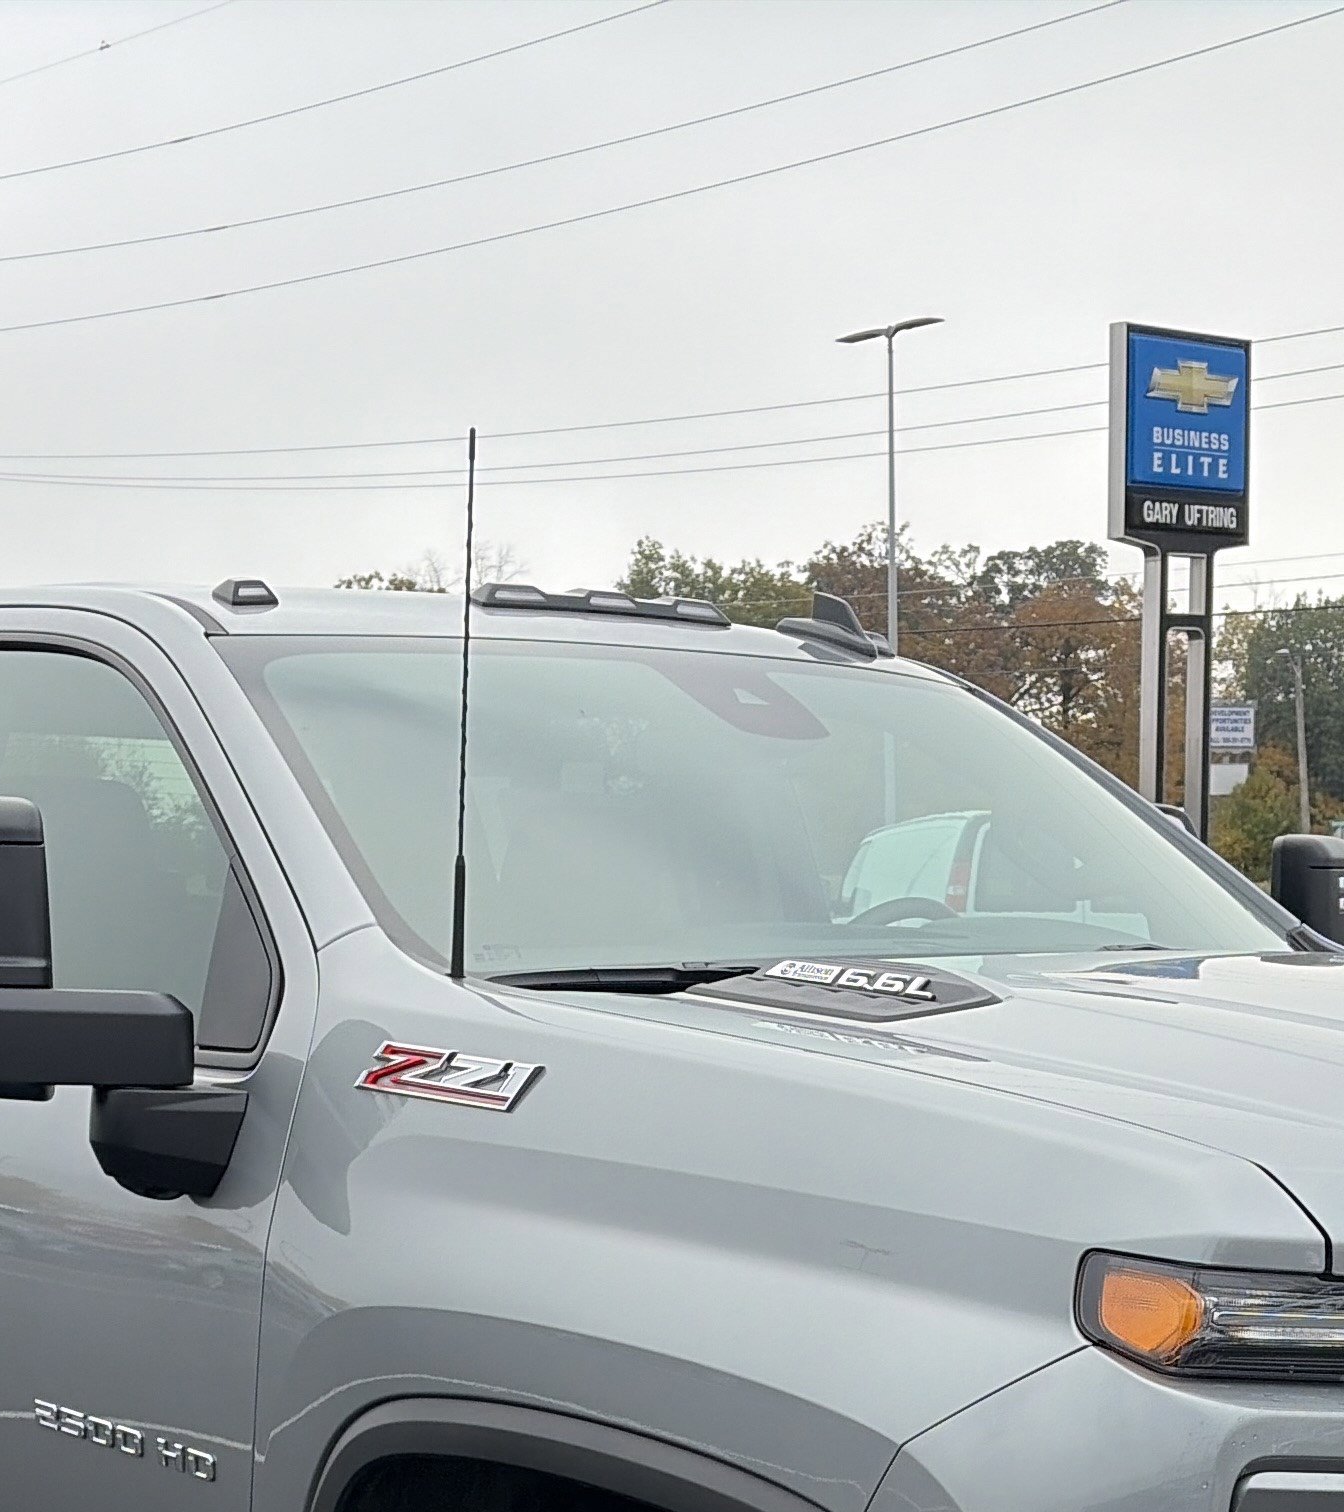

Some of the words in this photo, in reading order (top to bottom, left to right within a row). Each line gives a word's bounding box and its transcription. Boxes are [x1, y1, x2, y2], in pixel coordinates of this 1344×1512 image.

[1152, 427, 1229, 451] BUSINESS
[1152, 452, 1229, 479] ELITE
[1143, 500, 1179, 525] GARY
[1185, 503, 1237, 529] UFTRING
[837, 968, 937, 1001] 6.6L
[354, 1040, 546, 1113] Z71
[35, 1398, 144, 1458] 2500
[156, 1437, 216, 1482] HD
